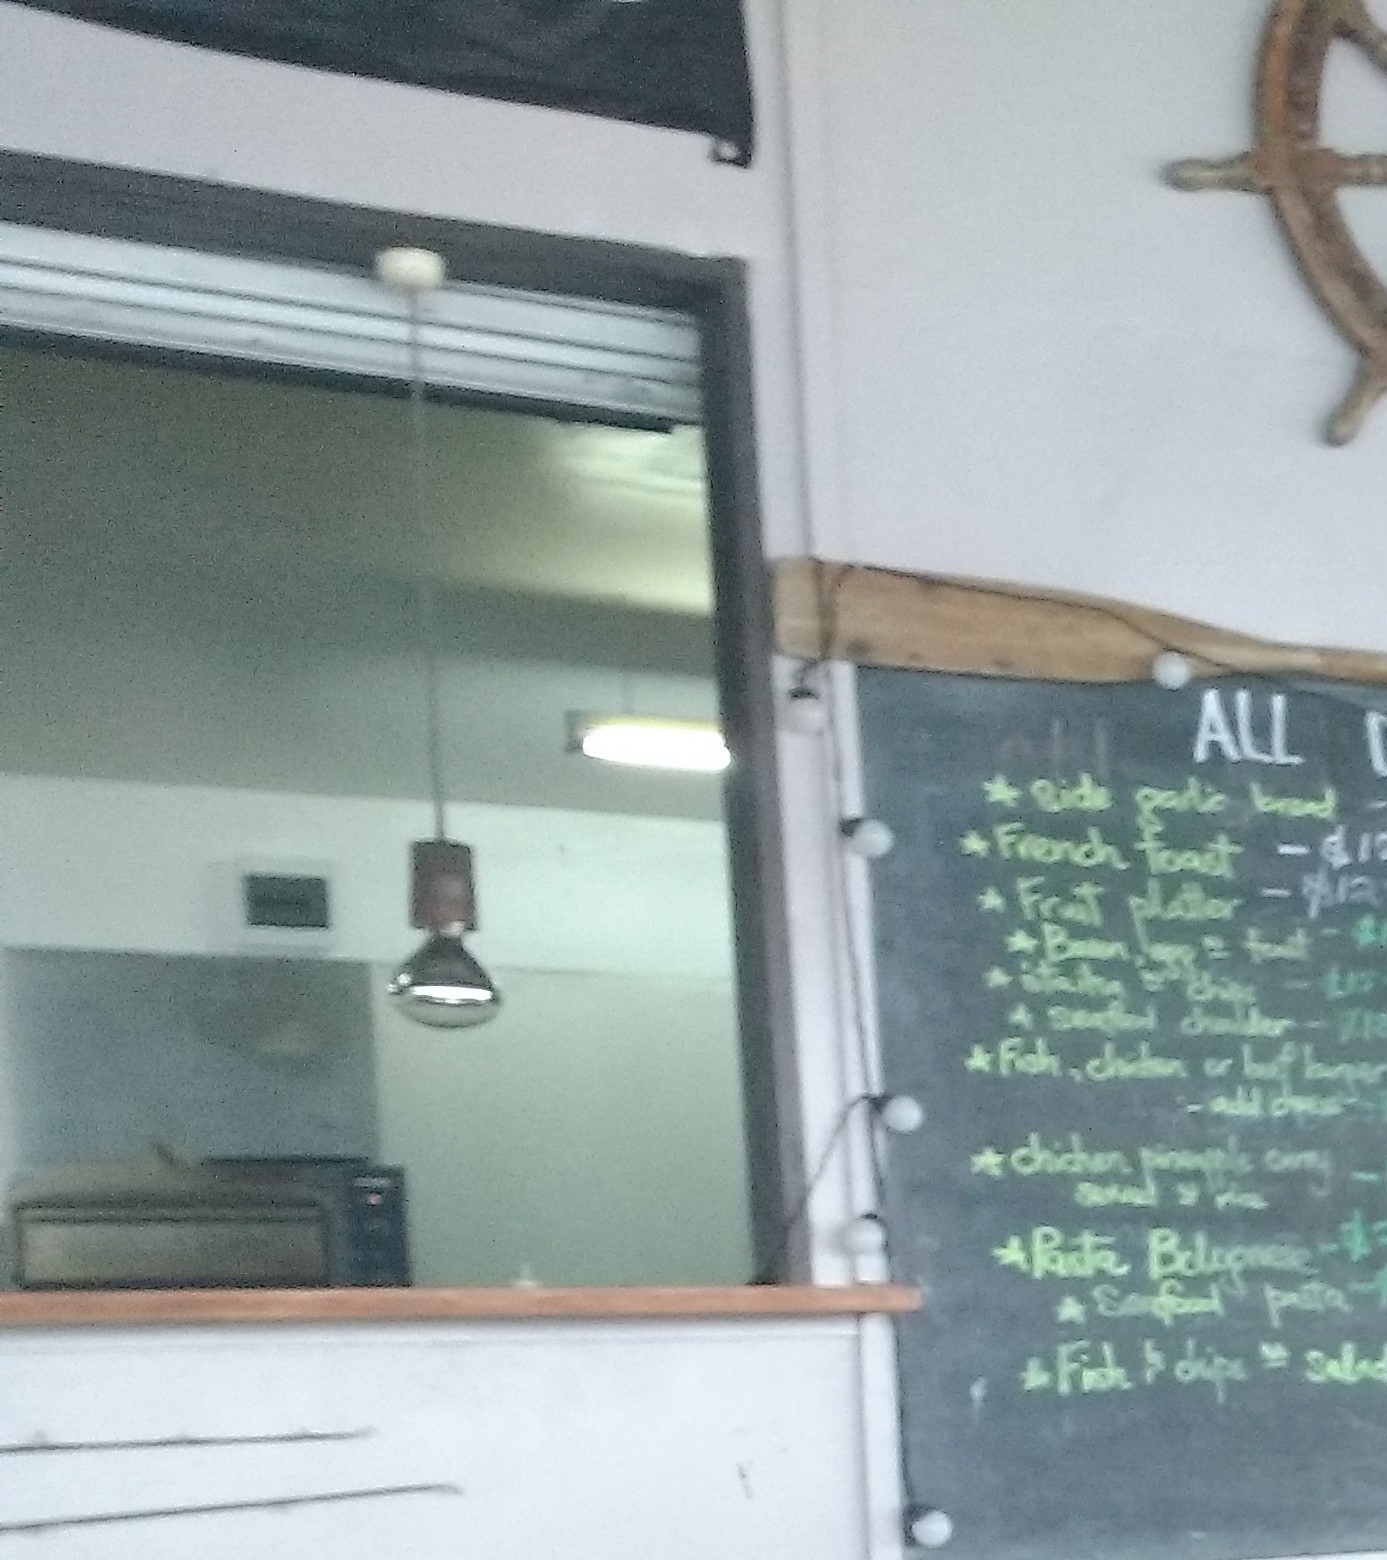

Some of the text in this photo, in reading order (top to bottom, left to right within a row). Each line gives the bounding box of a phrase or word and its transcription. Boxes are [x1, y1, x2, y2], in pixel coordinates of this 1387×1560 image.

[1194, 688, 1304, 764] ALL
[994, 822, 1130, 871] French
[1057, 1340, 1133, 1396] Fish
